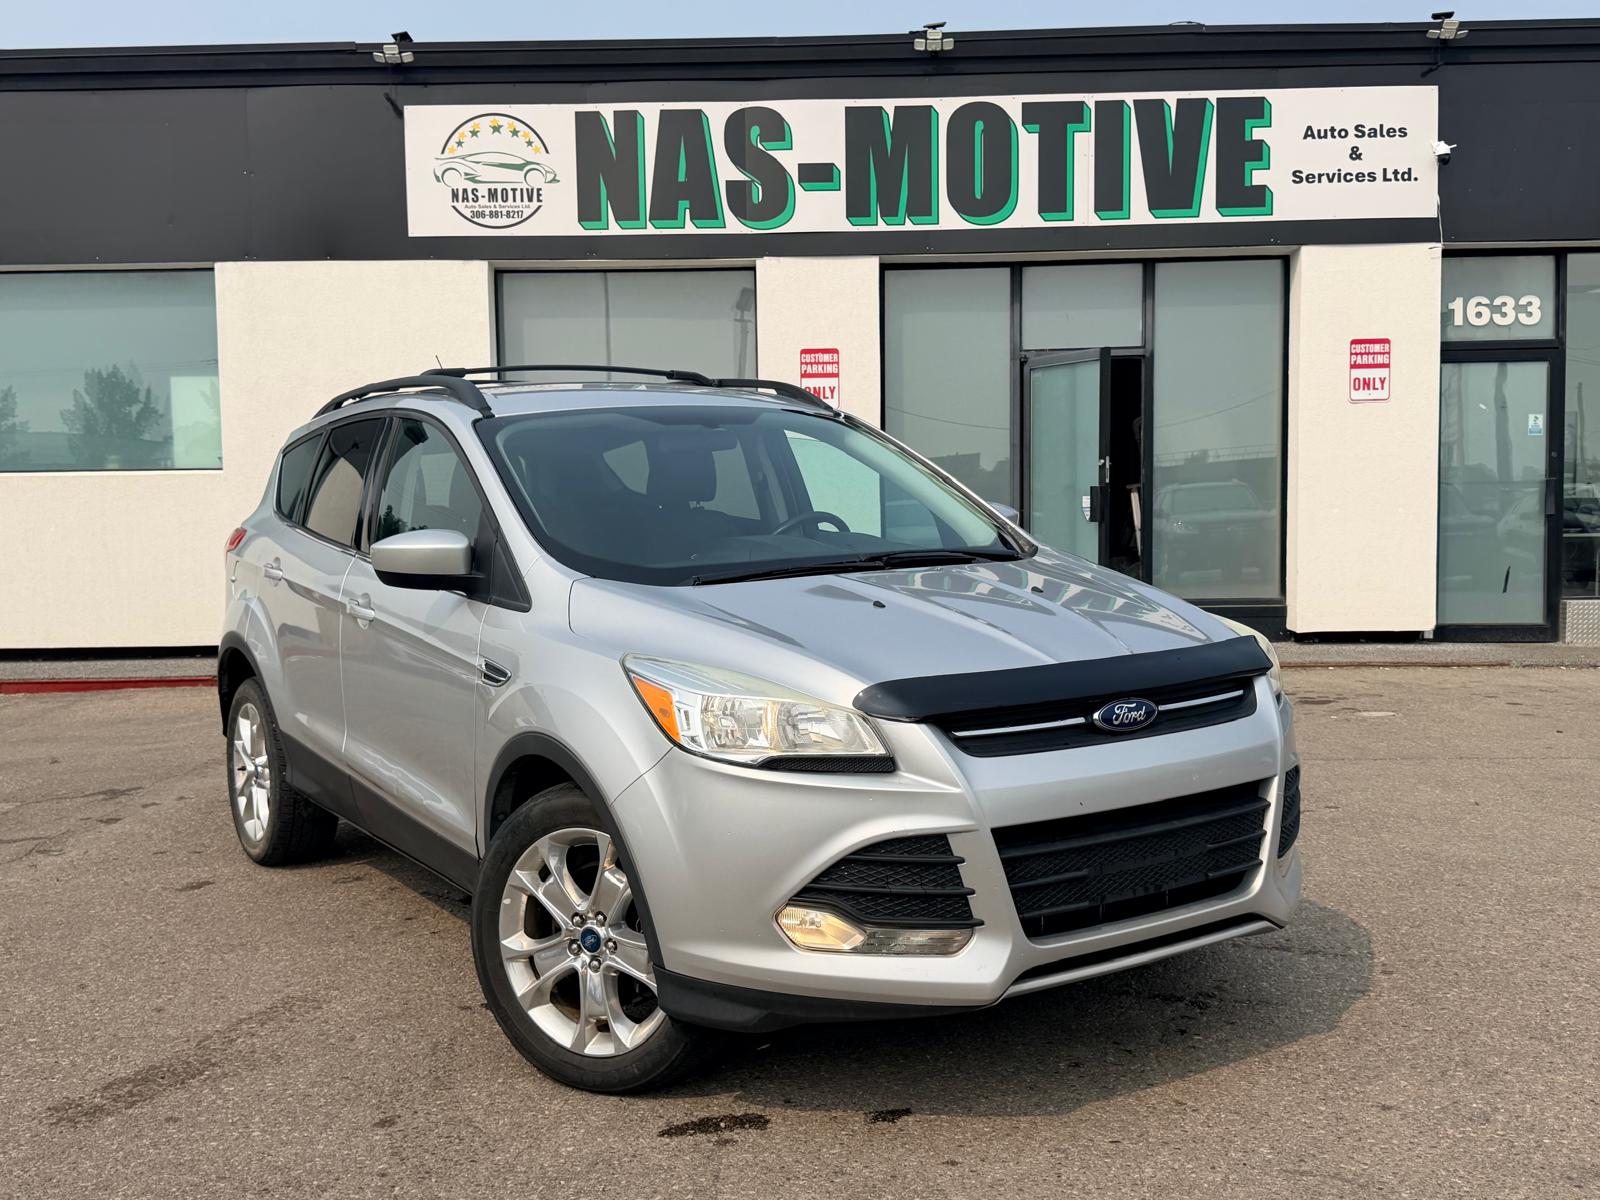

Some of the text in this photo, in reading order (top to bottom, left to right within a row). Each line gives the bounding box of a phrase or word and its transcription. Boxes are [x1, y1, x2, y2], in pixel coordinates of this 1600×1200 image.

[1302, 124, 1408, 140] Auto Sales
[1348, 145, 1363, 161] &
[575, 96, 1274, 230] NAS-MOTIVE
[1291, 167, 1419, 184] Services Ltd.
[451, 187, 543, 203] NAS-MOTIVE
[470, 210, 524, 219] 306-881-8217
[1448, 294, 1542, 327] 1633
[1350, 343, 1390, 354] CUSTOMER
[801, 352, 839, 363] CUSTOMER
[1351, 353, 1390, 365] PARKING
[801, 363, 839, 374] PARKING
[1353, 376, 1387, 391] ONLY
[1112, 702, 1147, 725] Ford
